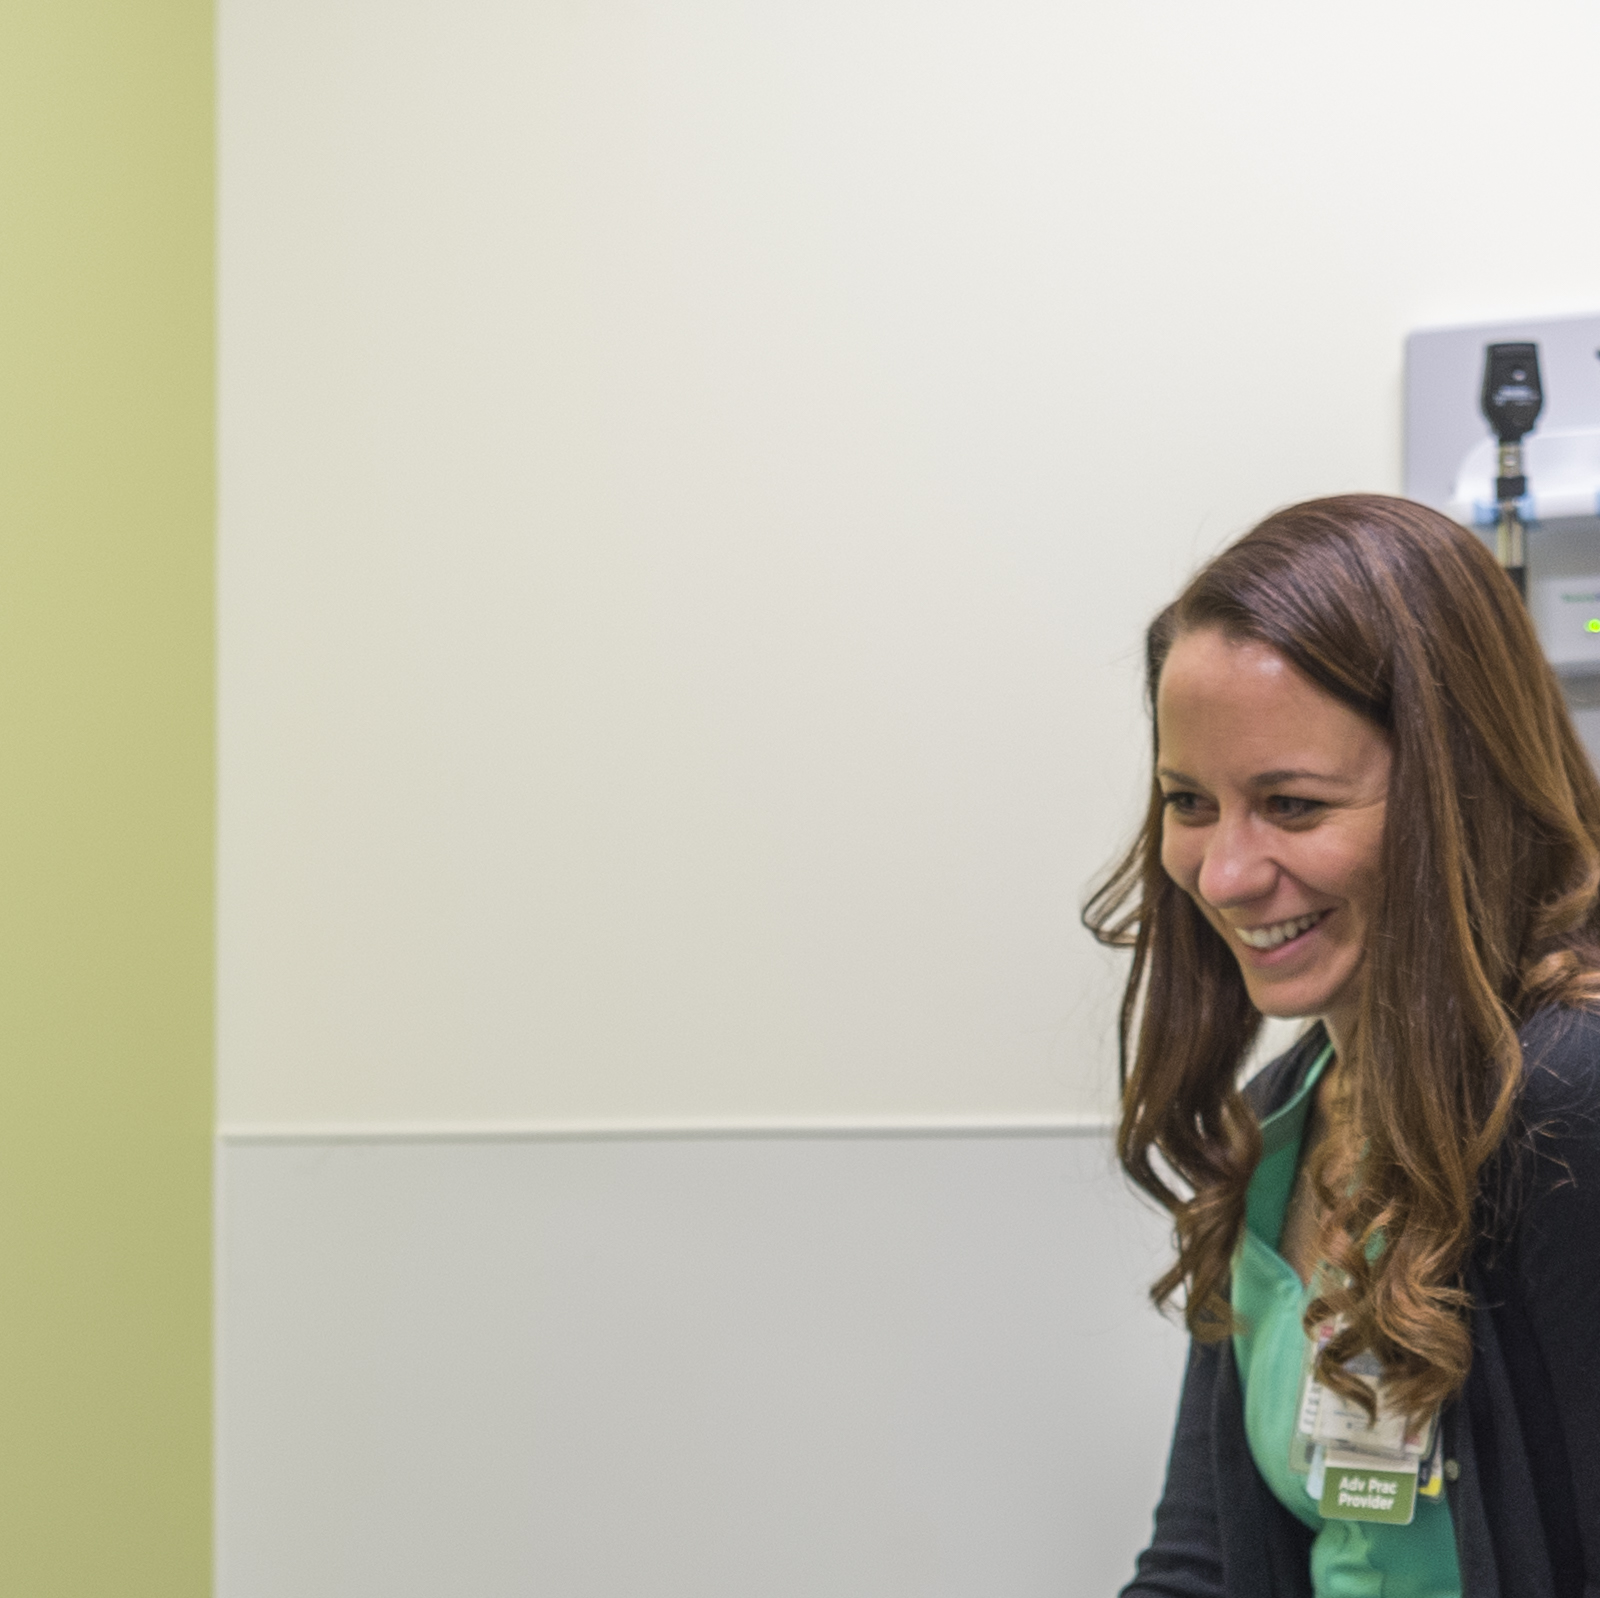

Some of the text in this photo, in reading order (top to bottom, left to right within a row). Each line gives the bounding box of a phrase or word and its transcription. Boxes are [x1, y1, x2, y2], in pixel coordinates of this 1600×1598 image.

[1339, 1476, 1399, 1496] Adv Prac
[1338, 1492, 1394, 1511] Provider
